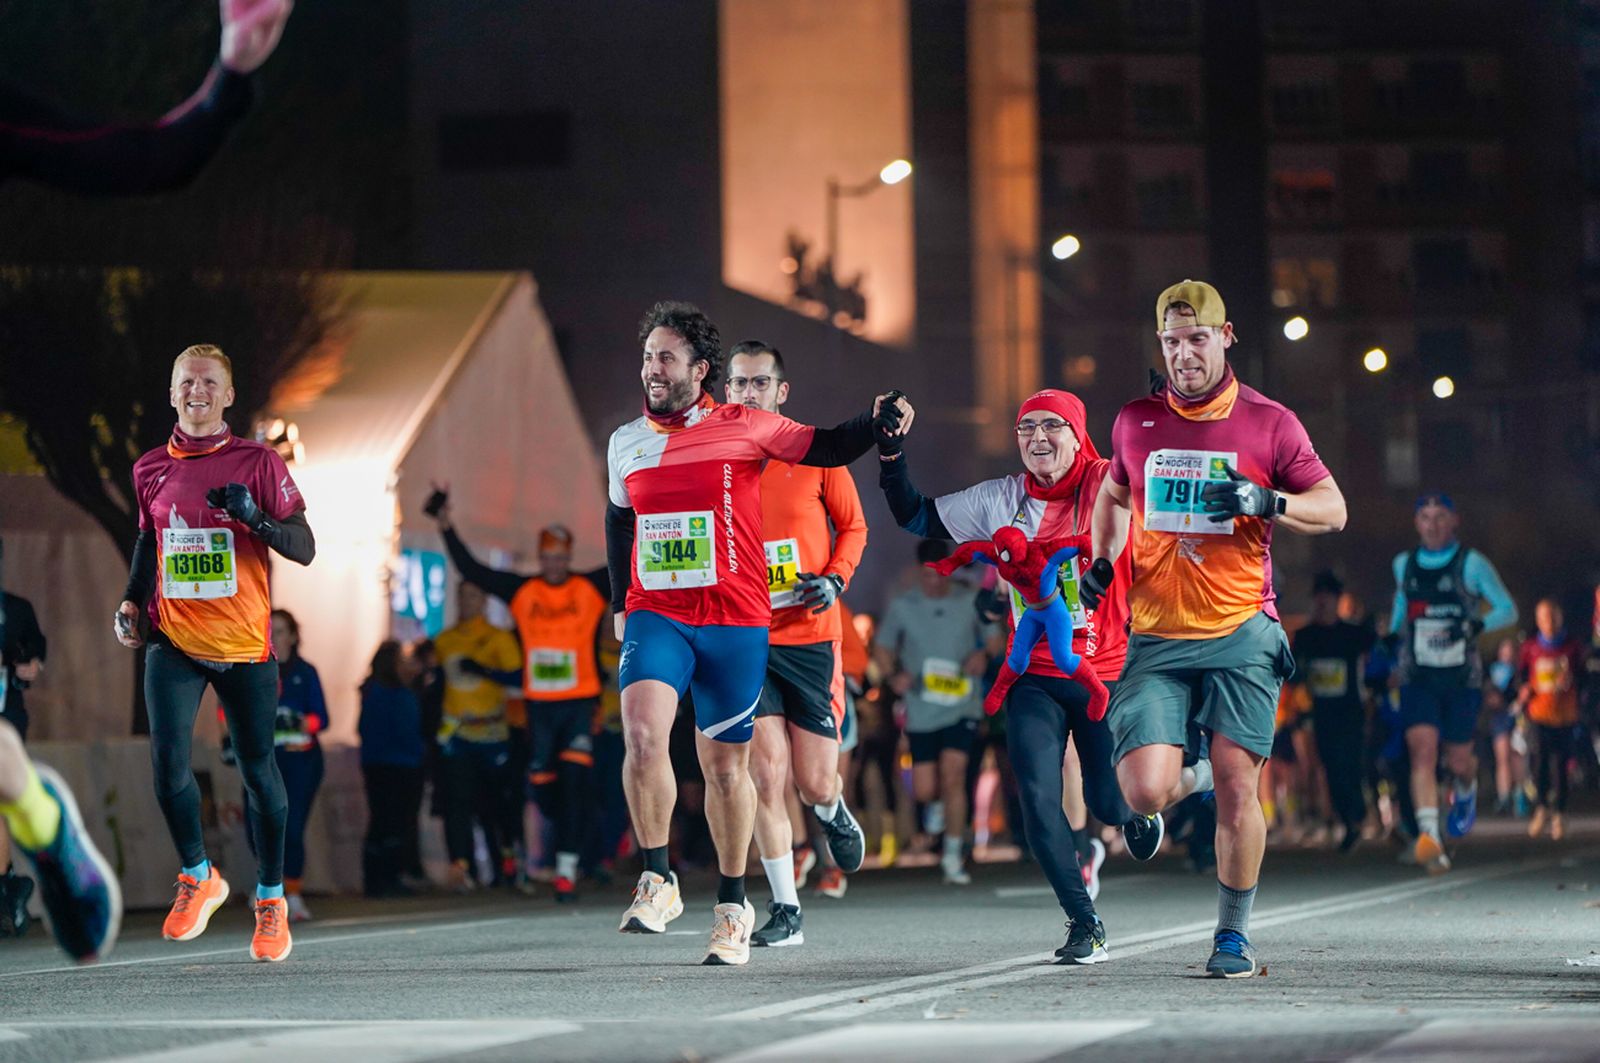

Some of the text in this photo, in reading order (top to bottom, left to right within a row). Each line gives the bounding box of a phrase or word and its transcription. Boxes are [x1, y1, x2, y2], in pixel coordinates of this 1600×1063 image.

[1165, 459, 1203, 468] NOCHE DE
[723, 463, 733, 489] CLUB
[1154, 468, 1171, 477] SAN
[651, 521, 682, 530] NOCHE DE
[652, 539, 697, 564] 9144
[171, 553, 225, 575] 13168
